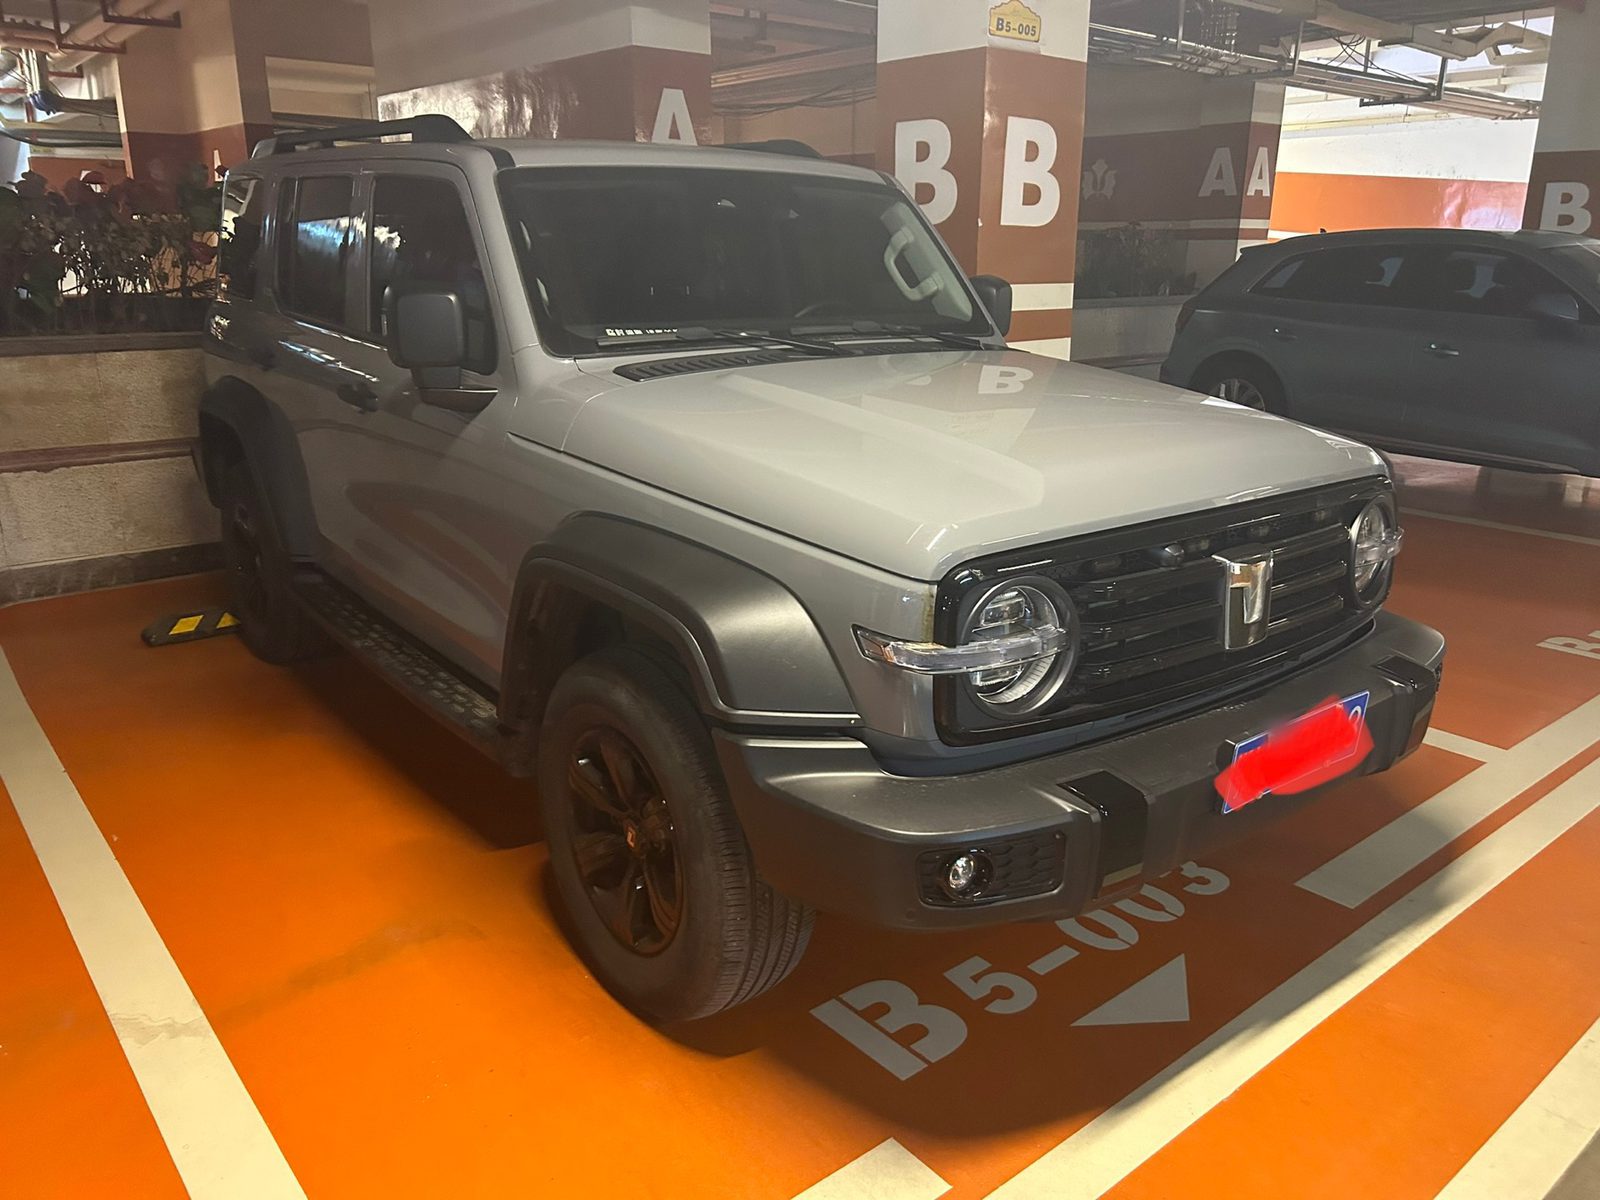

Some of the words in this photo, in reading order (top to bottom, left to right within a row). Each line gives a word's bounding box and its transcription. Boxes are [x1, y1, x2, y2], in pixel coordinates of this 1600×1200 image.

[996, 17, 1037, 37] B5-005
[651, 87, 698, 146] A
[895, 119, 958, 225] B
[1000, 116, 1061, 227] B
[1198, 147, 1237, 197] A
[1247, 146, 1270, 197] A
[1540, 182, 1592, 234] B
